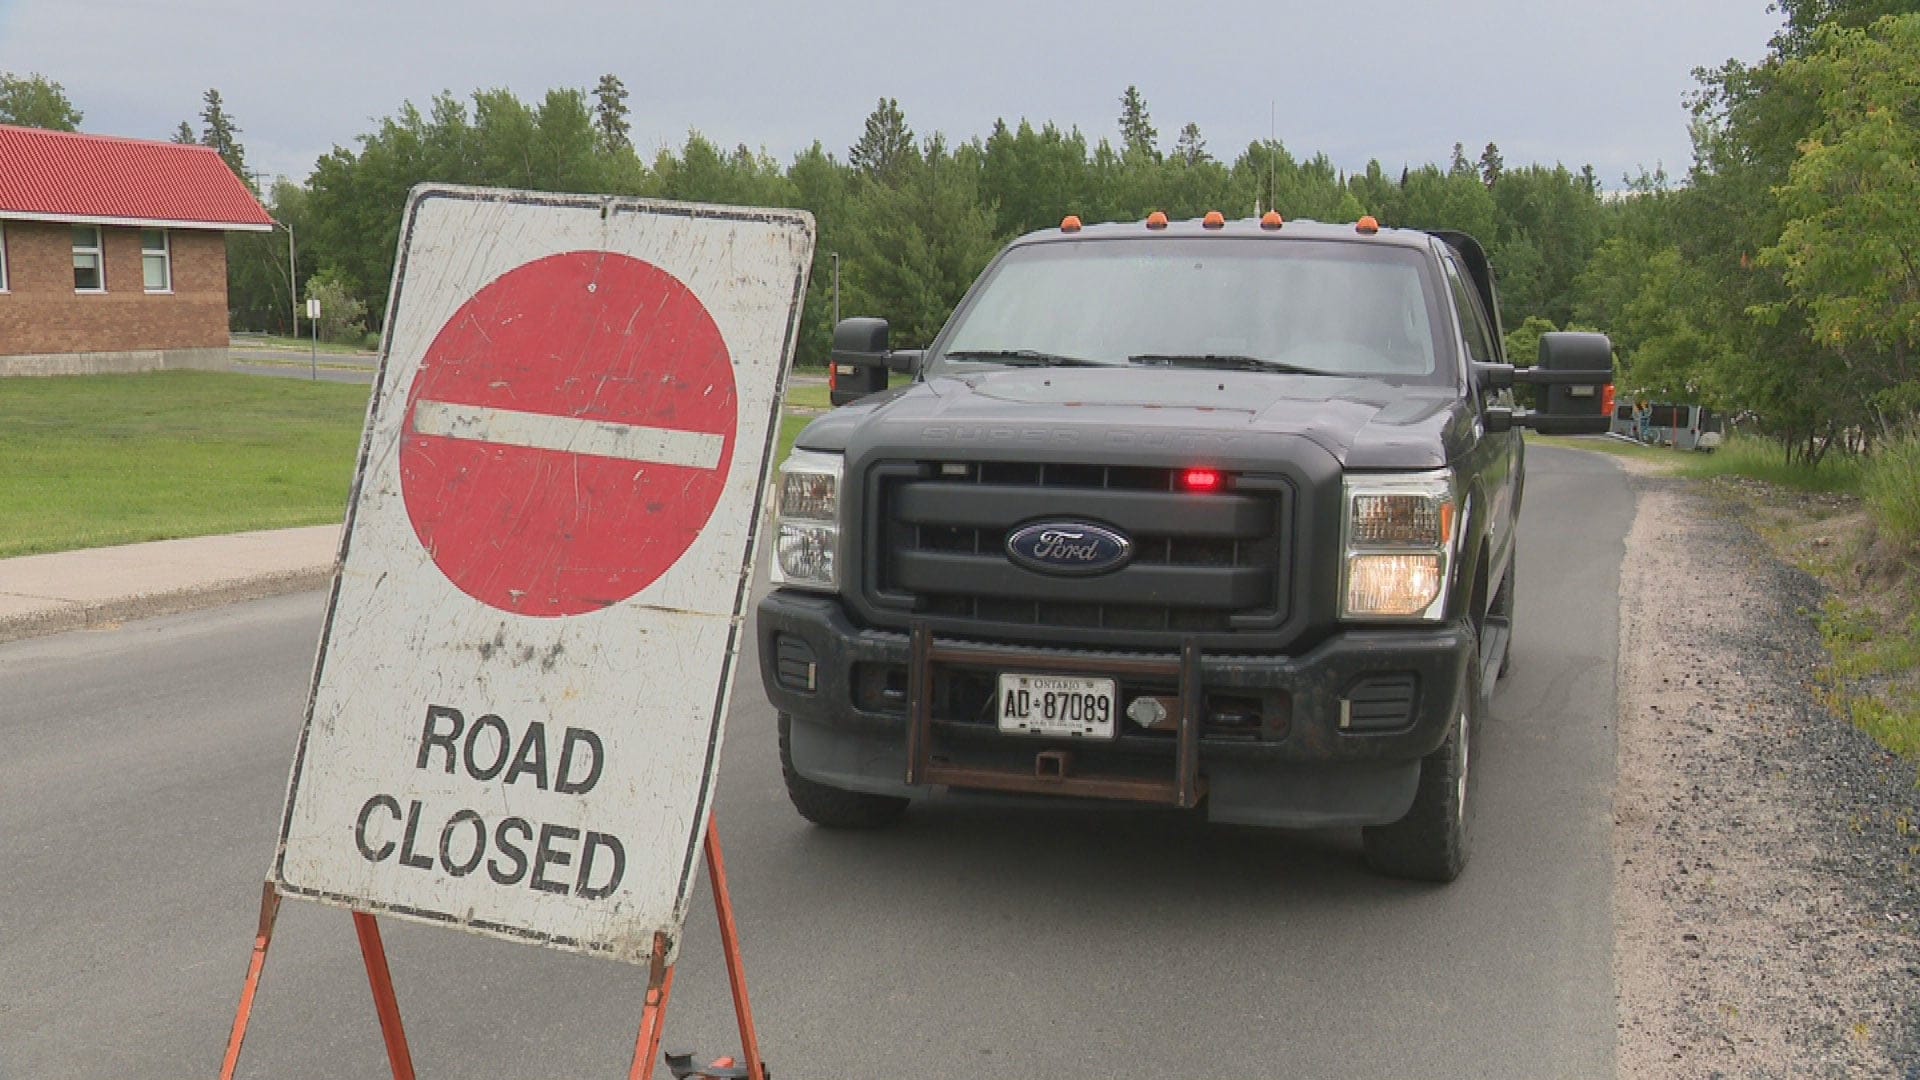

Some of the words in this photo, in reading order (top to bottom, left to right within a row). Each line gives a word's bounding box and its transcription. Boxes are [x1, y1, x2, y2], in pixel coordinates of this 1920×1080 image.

[920, 425, 1081, 445] SUPER
[1104, 430, 1241, 451] DUTY
[1033, 529, 1098, 562] Ford
[1034, 678, 1080, 690] ONTARIO
[416, 703, 604, 795] ROAD
[355, 794, 626, 900] CLOSED
